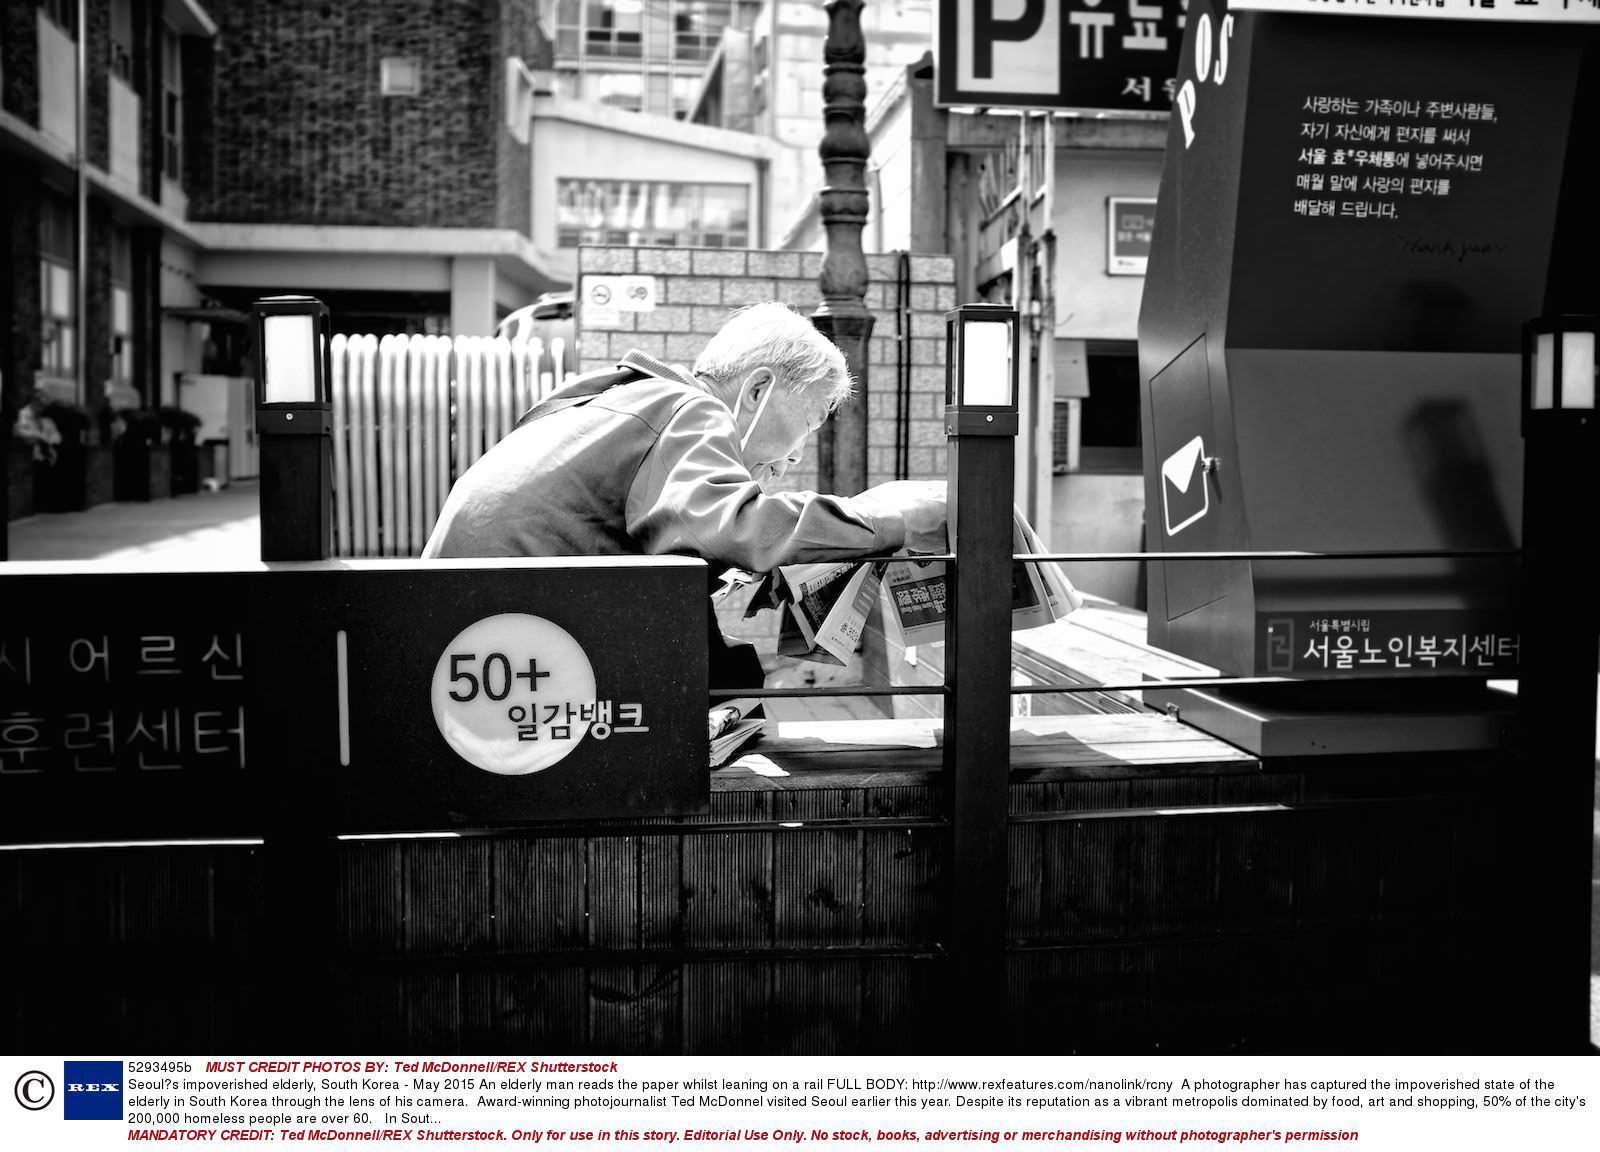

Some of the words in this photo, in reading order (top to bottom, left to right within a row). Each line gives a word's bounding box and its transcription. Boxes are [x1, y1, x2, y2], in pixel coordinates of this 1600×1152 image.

[972, 0, 1046, 79] P
[1302, 96, 1360, 115] 사랑하는
[1365, 98, 1421, 117] 가족이나
[1426, 101, 1498, 123] 주변사람들,
[1300, 122, 1329, 140] 자기
[1334, 123, 1391, 142] 자신에게
[1396, 125, 1437, 144] 편지를
[1443, 127, 1471, 146] 써서
[1298, 147, 1327, 165] 서울
[1415, 153, 1484, 172] 넣어주시면
[1296, 173, 1324, 191] 매월
[1330, 174, 1357, 192] 말에
[1363, 176, 1404, 194] 사랑의
[1410, 178, 1451, 195] 편지를
[1294, 199, 1336, 217] 배달해
[1340, 201, 1399, 219] 드립니다.
[1309, 618, 1371, 633] 서울특별시립
[1303, 633, 1520, 669] 서울노인복지센터
[448, 653, 550, 703] 50+
[507, 699, 649, 741] 일감뱅크
